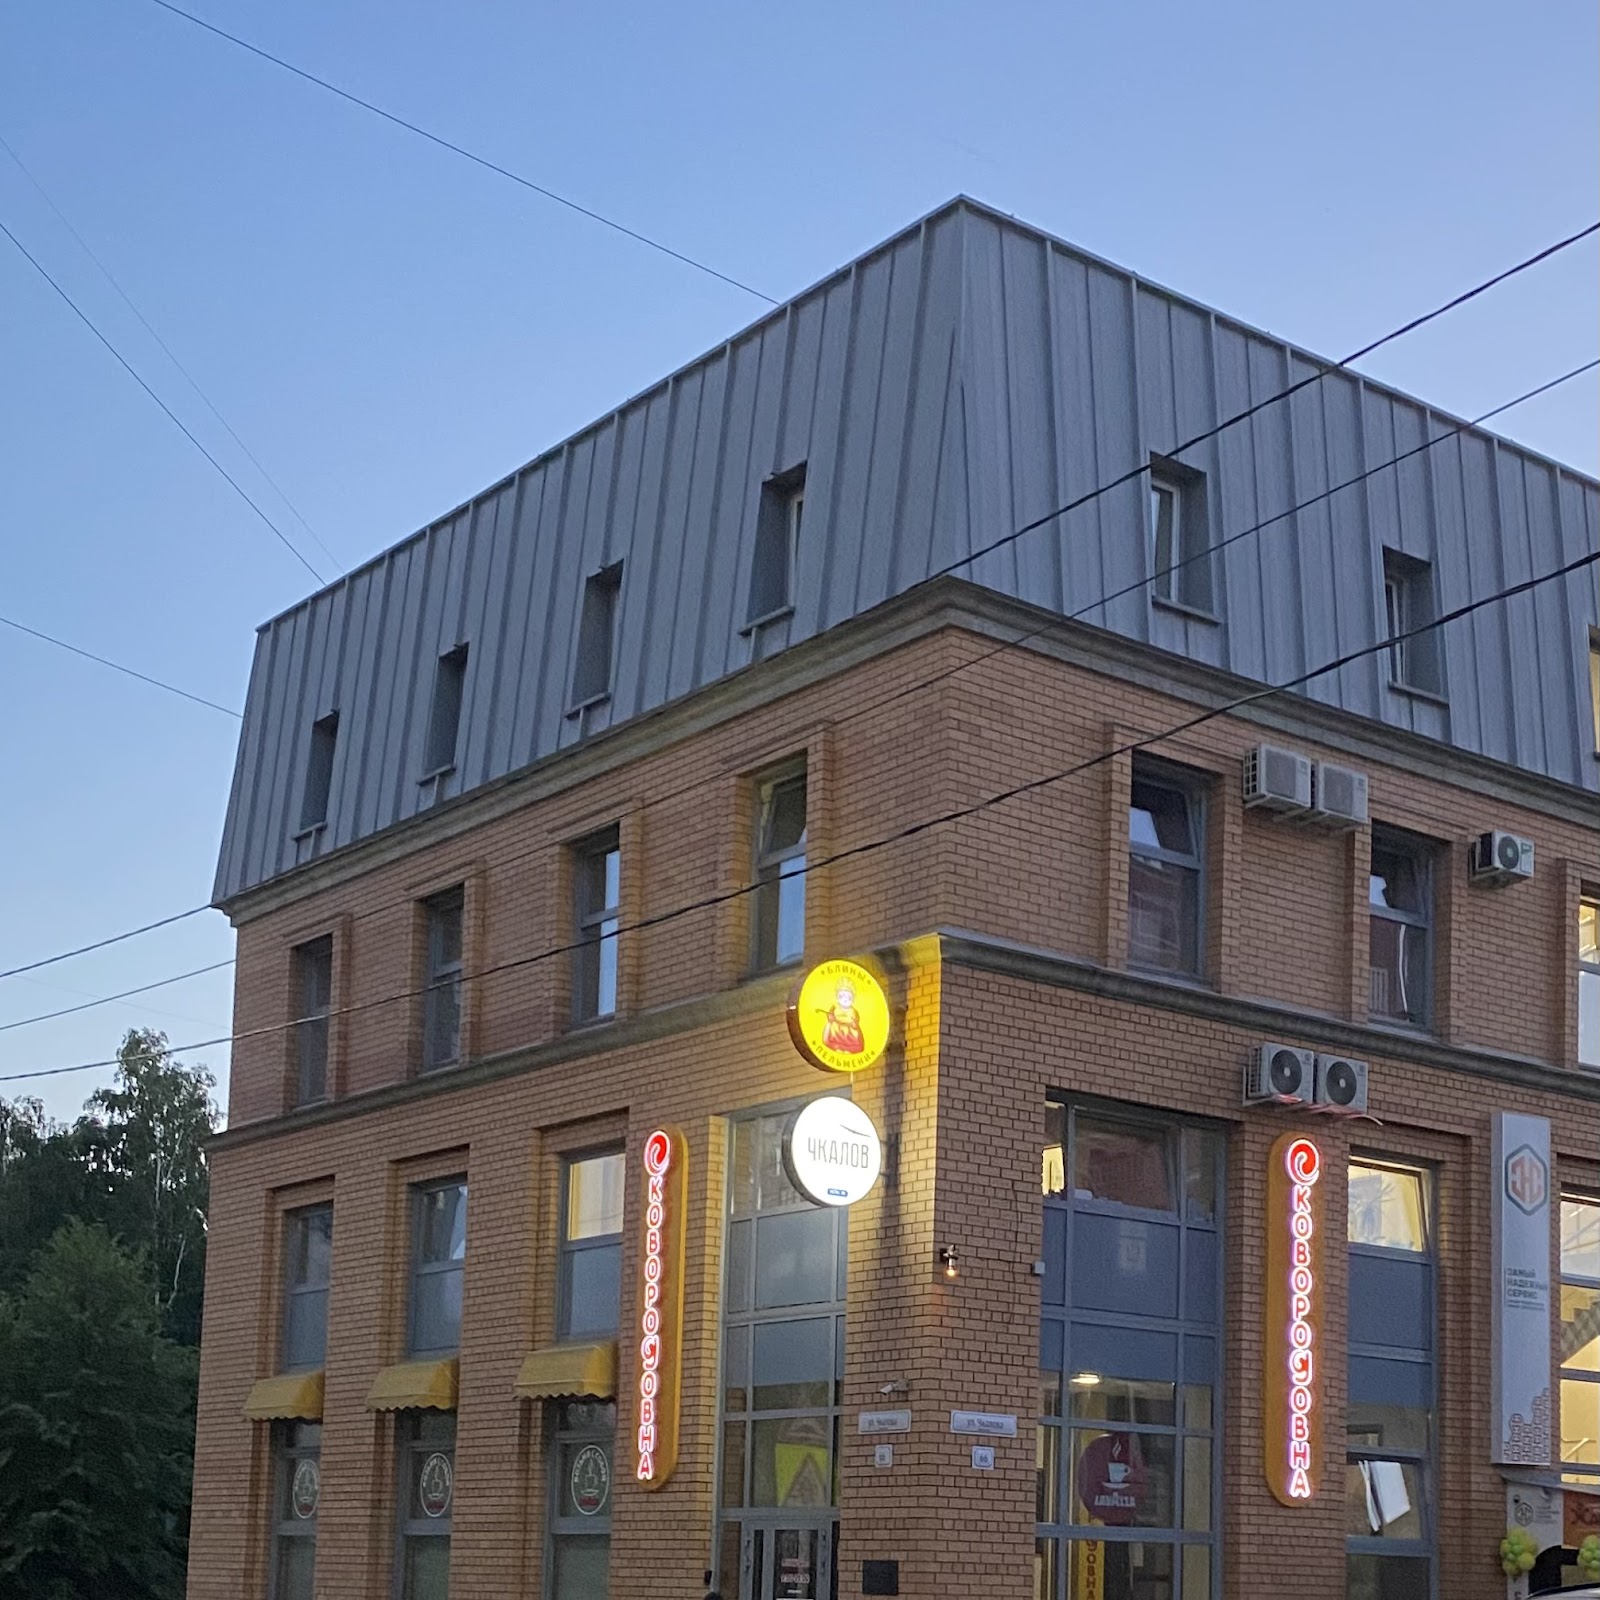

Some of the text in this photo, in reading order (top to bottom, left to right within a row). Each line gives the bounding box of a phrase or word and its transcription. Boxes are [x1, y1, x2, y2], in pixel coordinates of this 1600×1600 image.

[826, 965, 866, 982] БЛИНЫ
[815, 1045, 872, 1068] ПЕЛЬМЕНИ
[807, 1136, 869, 1169] ЧКАЛОВ
[1507, 1288, 1538, 1299] СЕРВИС
